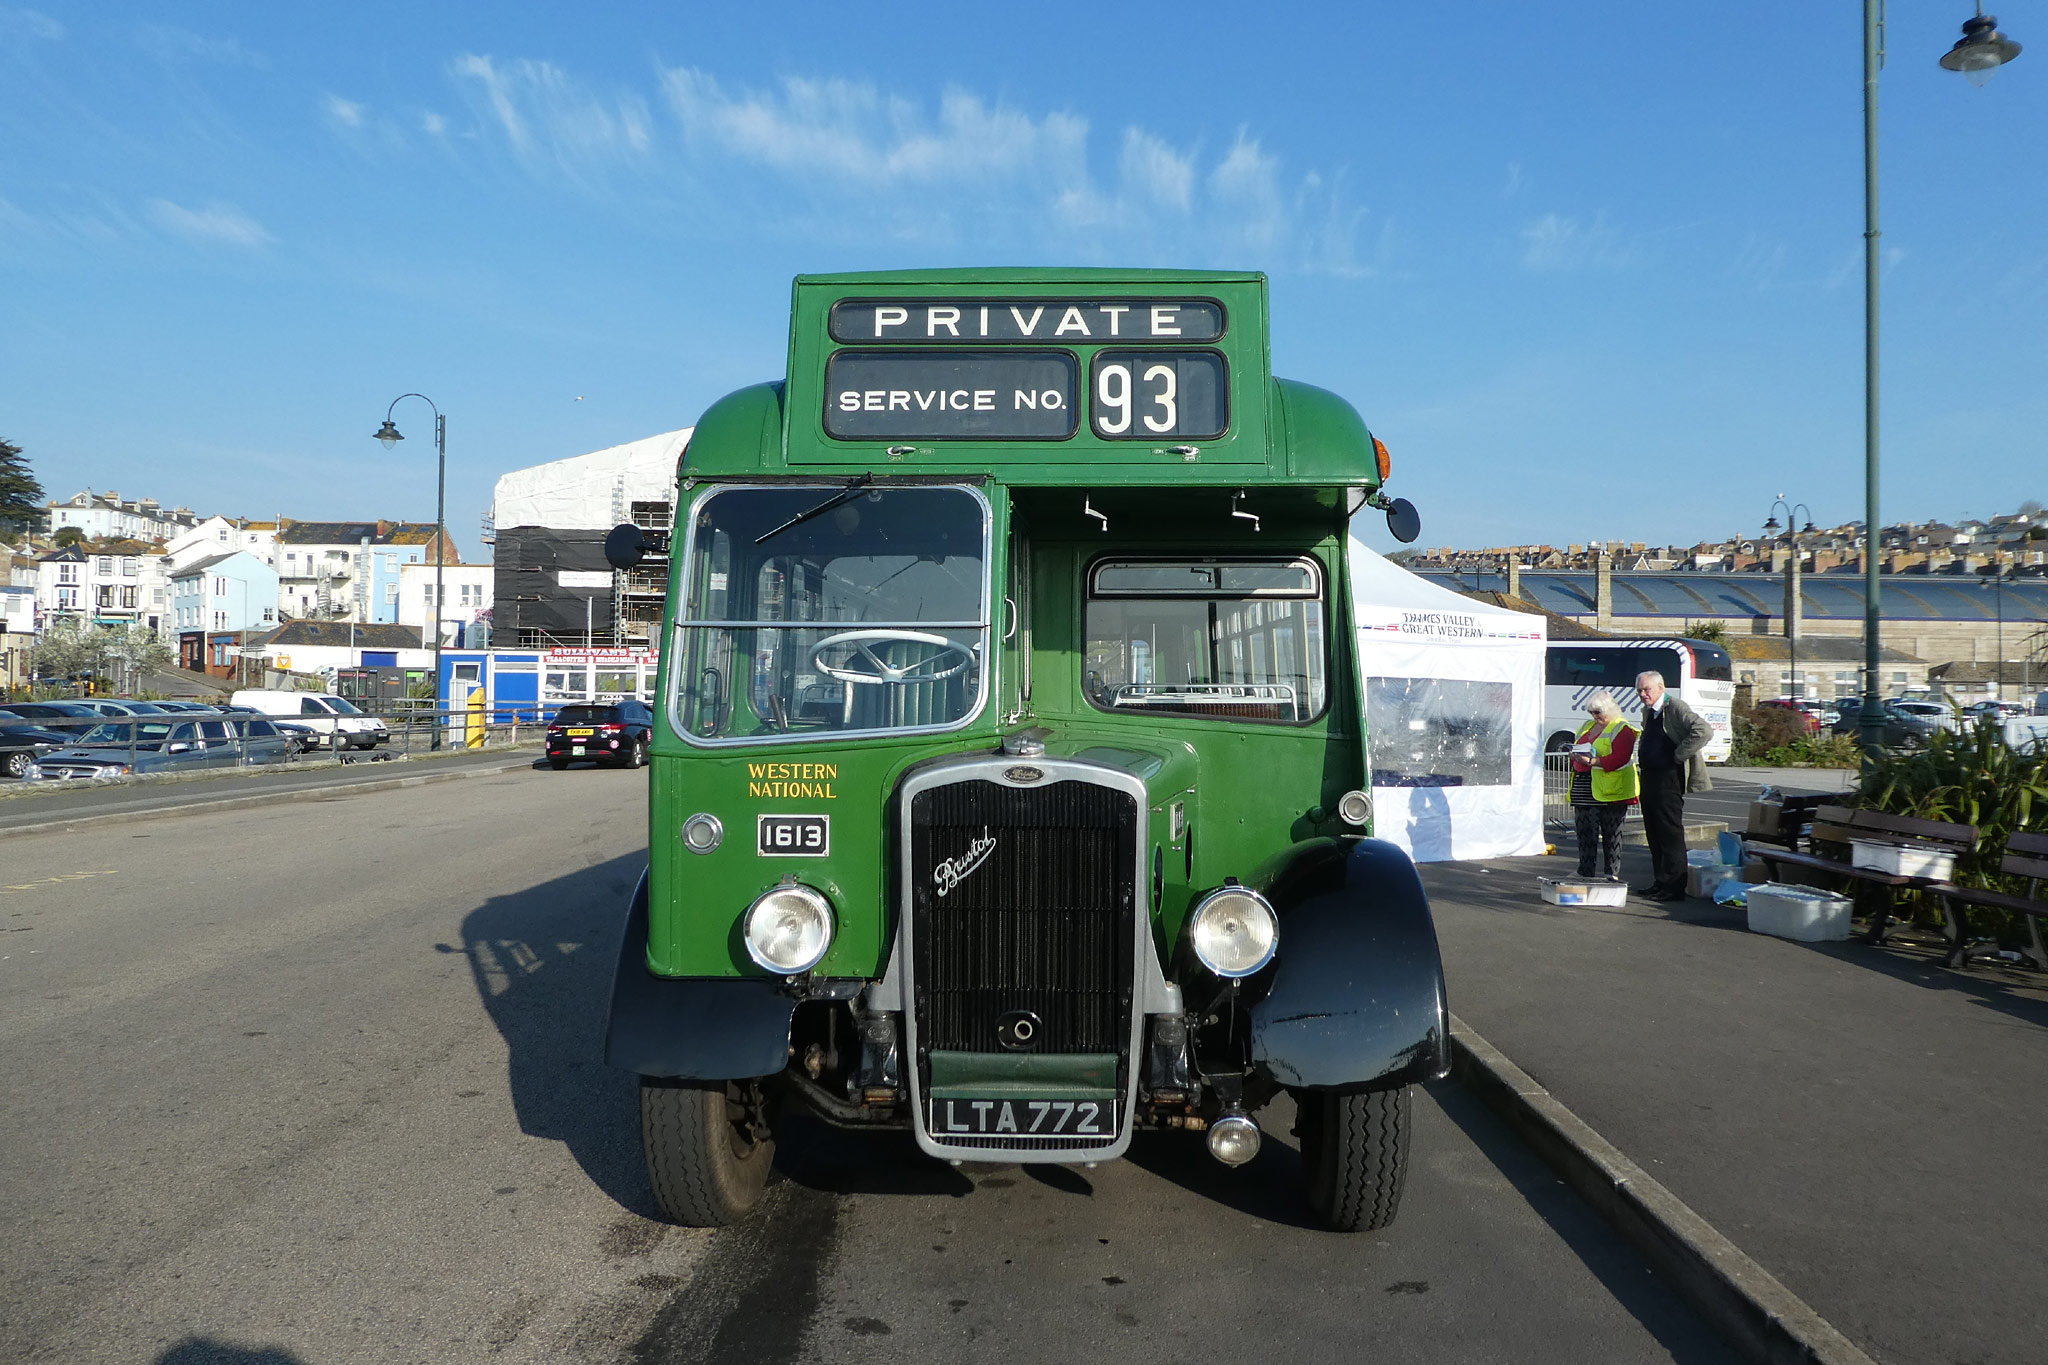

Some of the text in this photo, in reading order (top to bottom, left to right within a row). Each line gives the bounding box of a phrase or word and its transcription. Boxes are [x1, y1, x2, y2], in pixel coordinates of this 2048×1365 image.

[874, 305, 1182, 337] PRIVATE
[839, 389, 1067, 411] SERVICE NO.
[1098, 364, 1177, 434] 93
[1401, 623, 1484, 638] GREAT WESTERN
[1402, 612, 1441, 624] THAMES
[1442, 614, 1475, 627] VALLEY
[748, 763, 838, 779] WESTERN
[749, 782, 837, 798] NATIONAL
[765, 825, 822, 847] 1613
[934, 825, 997, 897] Bristol
[946, 1101, 1099, 1133] LTA 772
